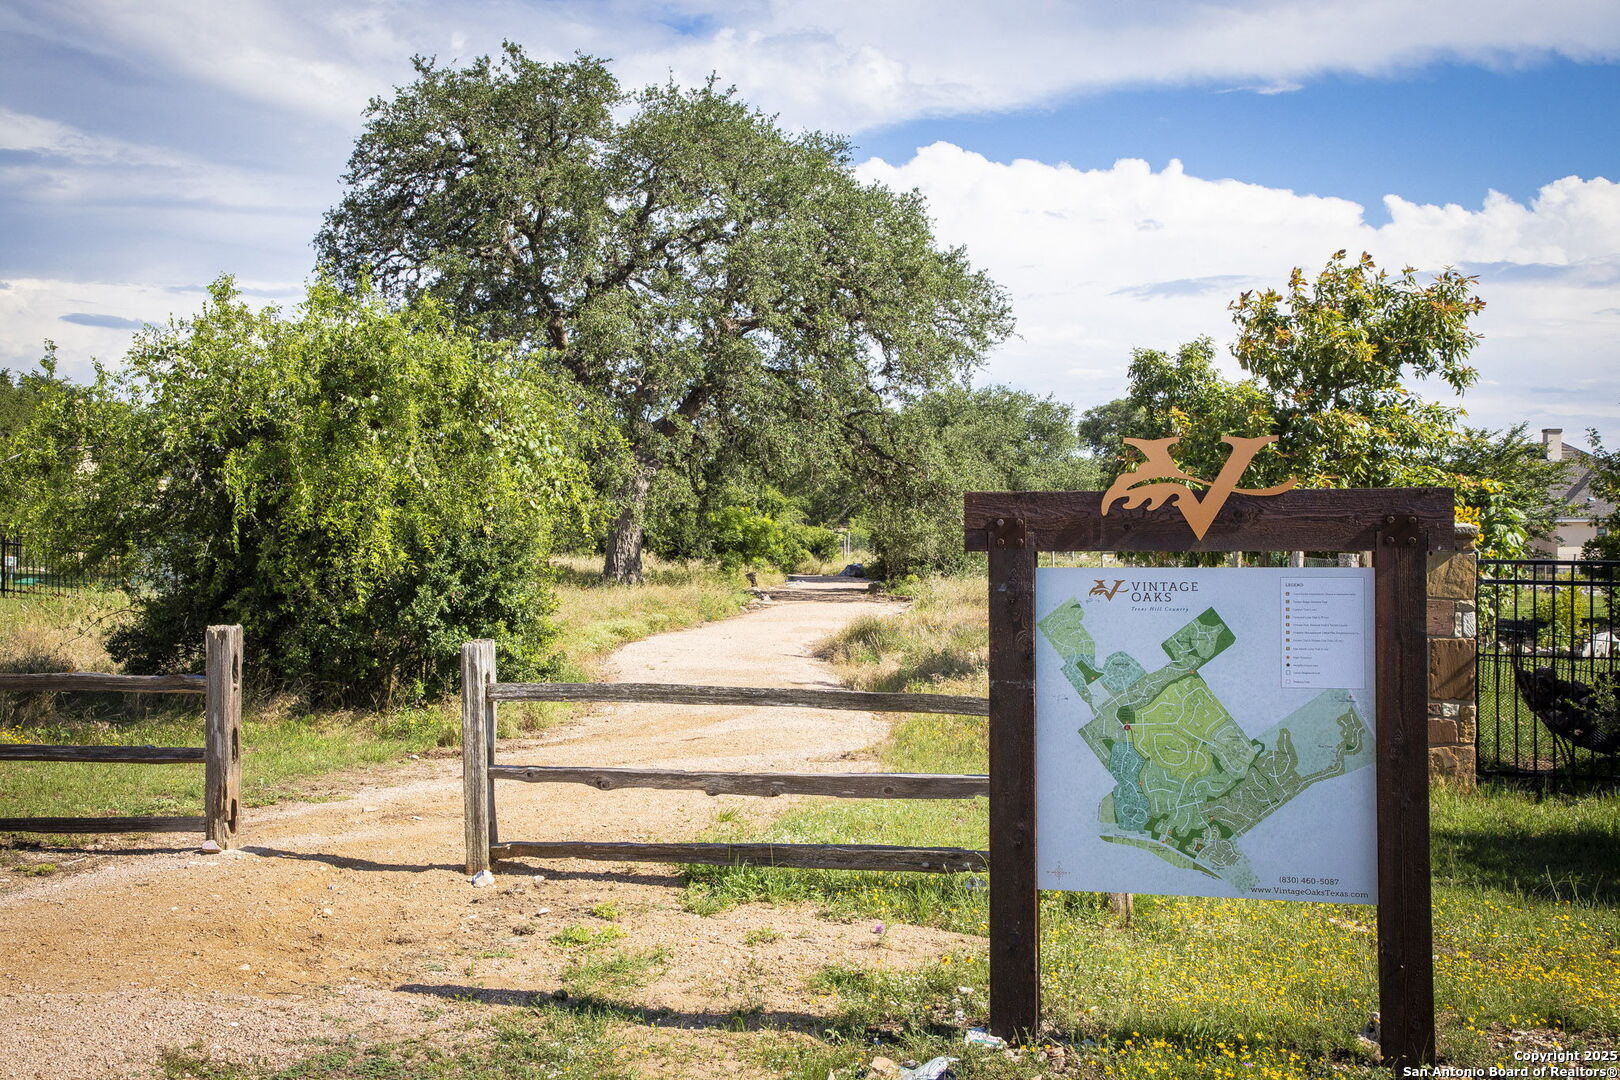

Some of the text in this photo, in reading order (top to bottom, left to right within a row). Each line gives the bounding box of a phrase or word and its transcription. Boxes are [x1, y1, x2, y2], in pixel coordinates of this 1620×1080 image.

[1131, 581, 1199, 592] VINTAGE
[1131, 592, 1172, 602] OAKS
[1279, 876, 1340, 885] (830) 460-5087
[1250, 887, 1369, 898] www.VintageOaksTexas.com
